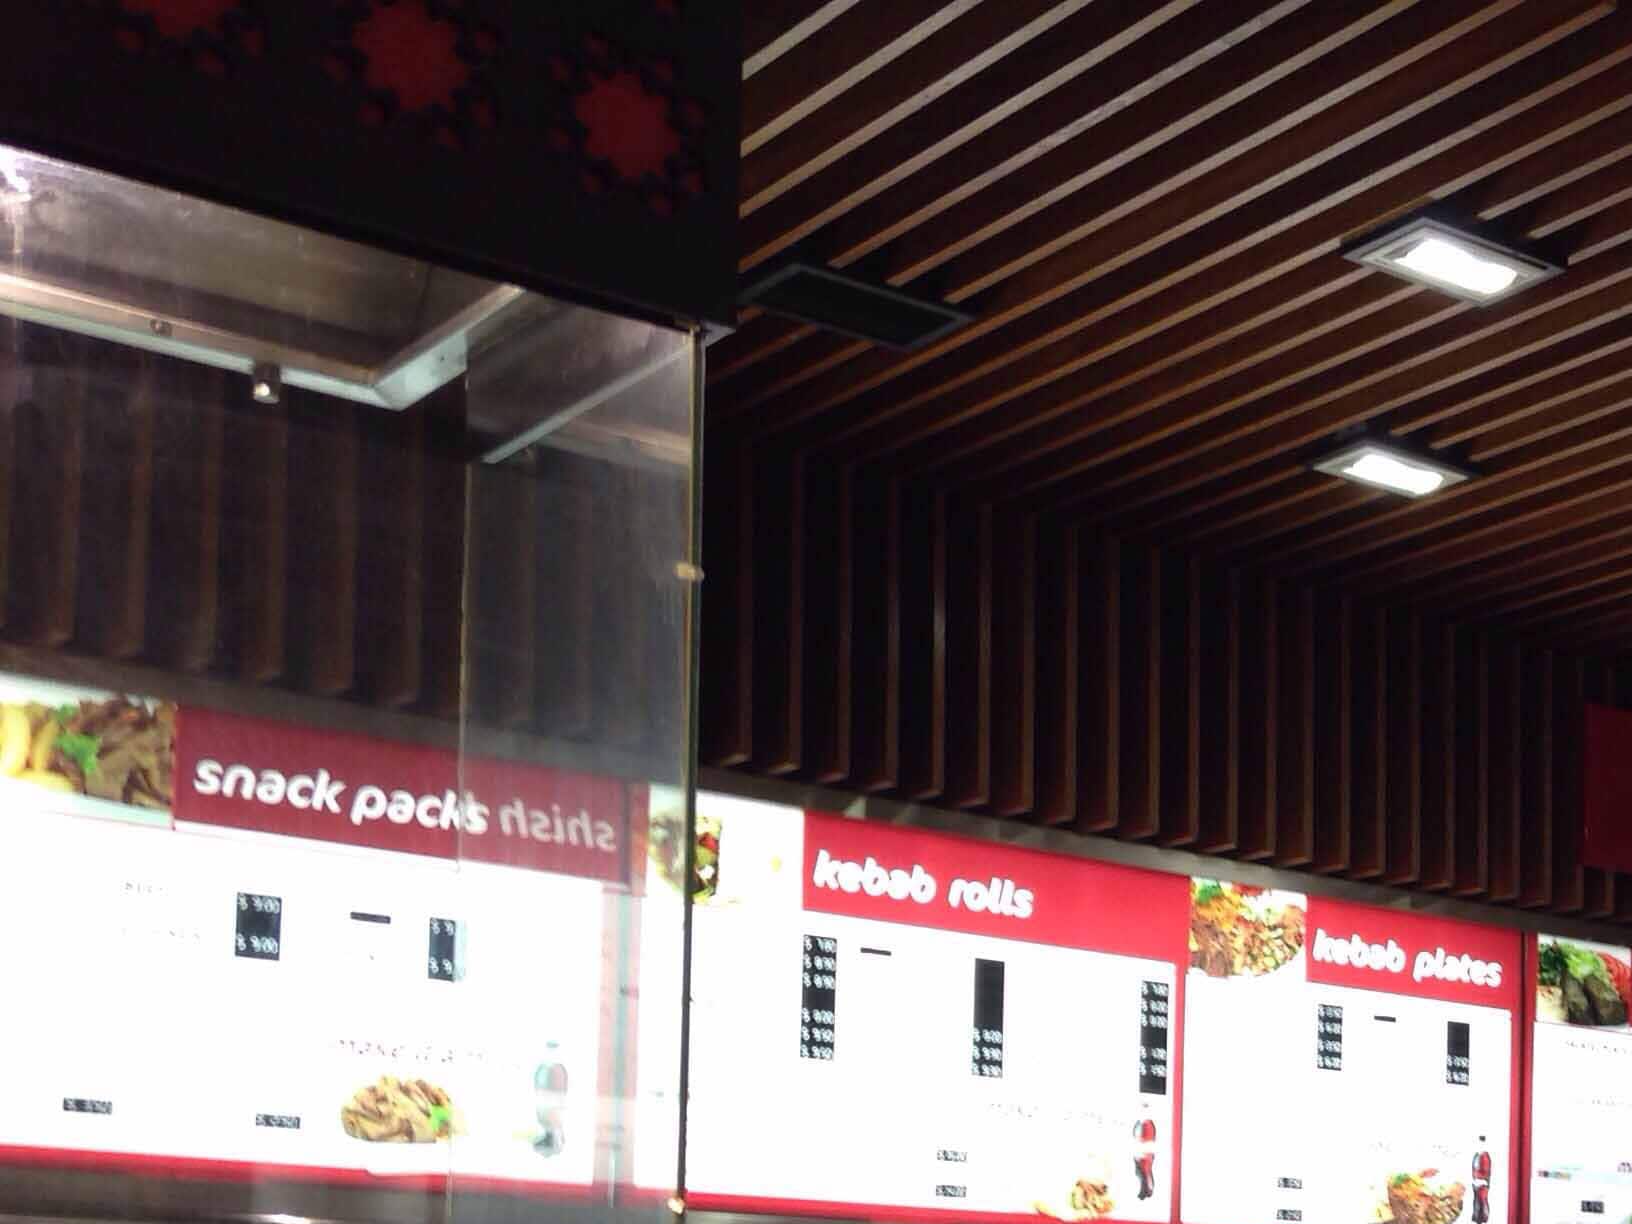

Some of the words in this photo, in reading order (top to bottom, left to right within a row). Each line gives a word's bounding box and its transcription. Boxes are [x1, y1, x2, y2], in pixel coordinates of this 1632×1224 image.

[192, 758, 347, 814] snack
[350, 785, 489, 834] packs
[813, 850, 937, 904] kebab
[948, 877, 1034, 919] rolls
[1312, 928, 1405, 973] kebab
[1413, 947, 1503, 988] plates
